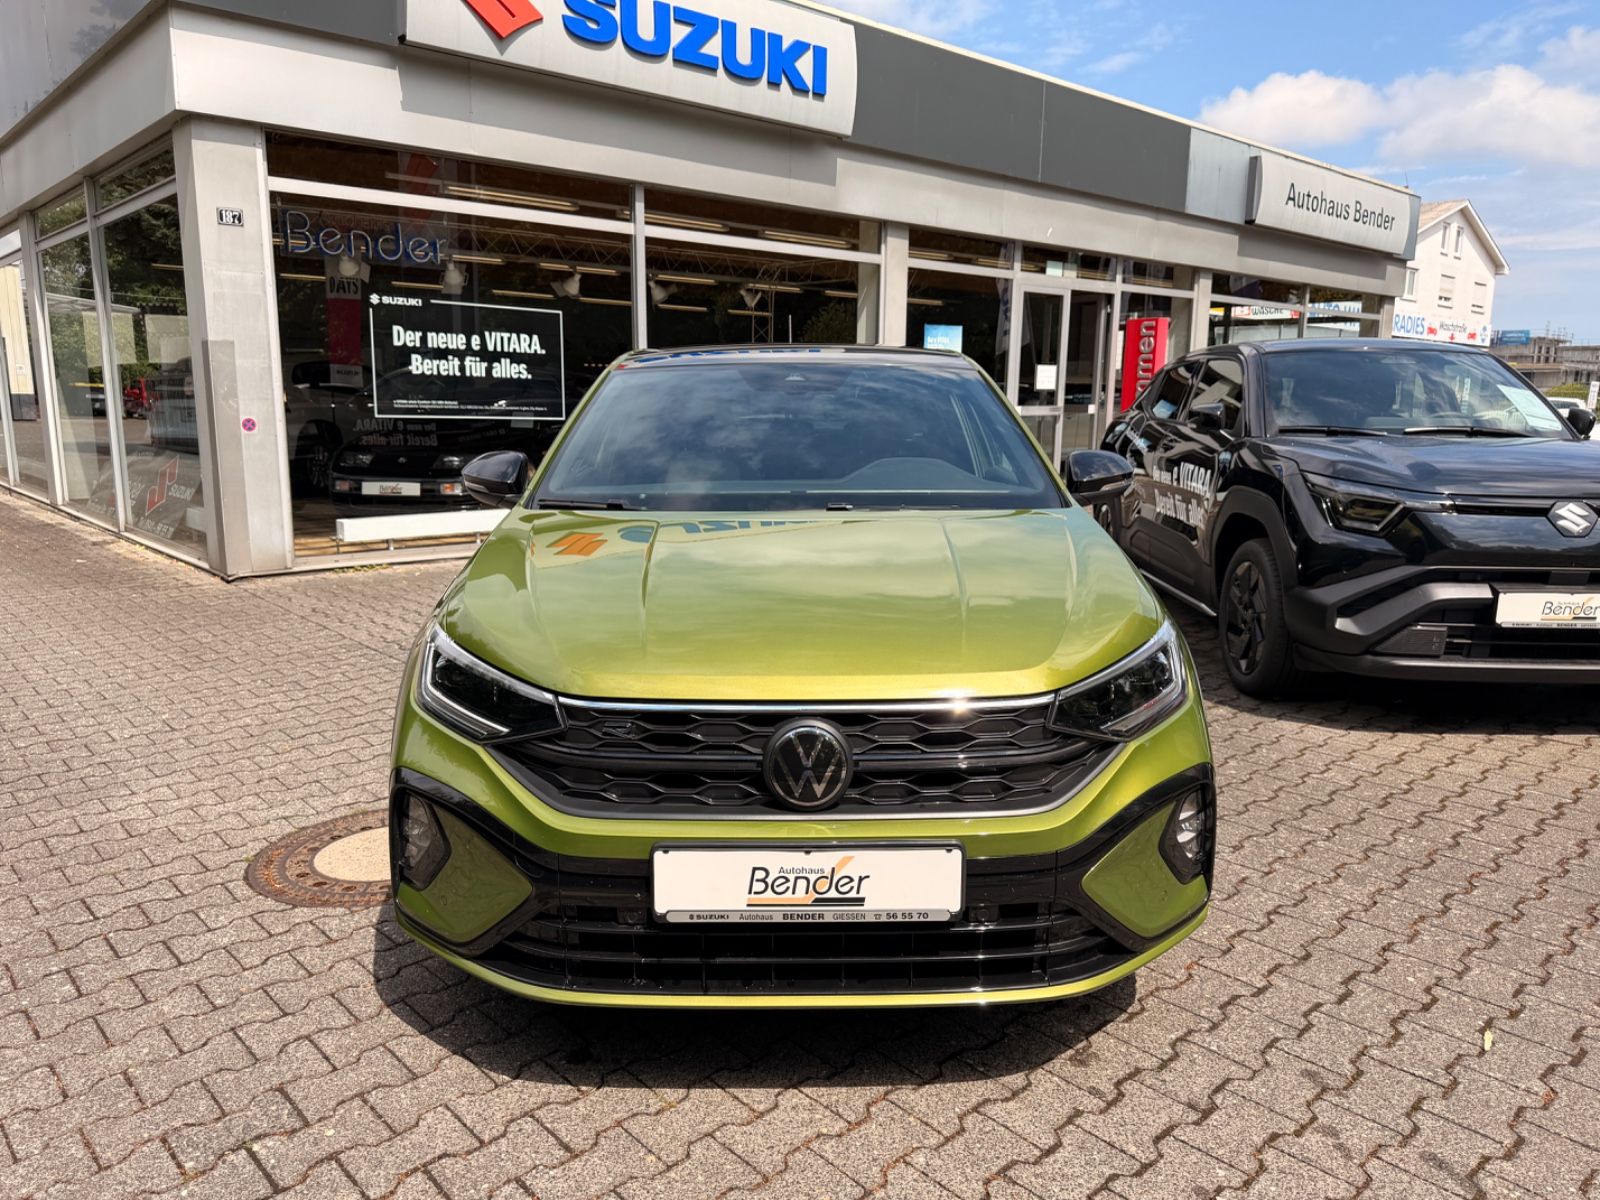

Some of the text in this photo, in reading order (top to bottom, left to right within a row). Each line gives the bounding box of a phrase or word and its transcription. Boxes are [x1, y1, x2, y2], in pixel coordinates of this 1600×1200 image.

[562, 0, 827, 96] SUZUKI
[220, 209, 242, 224] 187
[1286, 183, 1395, 231] Autohaus Bender
[285, 211, 447, 265] Bender
[381, 296, 422, 307] SUZUKI
[392, 325, 546, 354] Der neue e VITARA.
[410, 354, 532, 379] Bereit für alles.
[1541, 600, 1600, 616] Bender
[748, 866, 870, 896] Bender
[778, 866, 825, 875] Autohaus
[739, 913, 773, 921] Autohaus
[782, 913, 824, 921] BENDER
[833, 912, 866, 921] GIESSEN
[886, 912, 898, 920] 56
[901, 912, 913, 920] 55
[917, 912, 929, 920] 70
